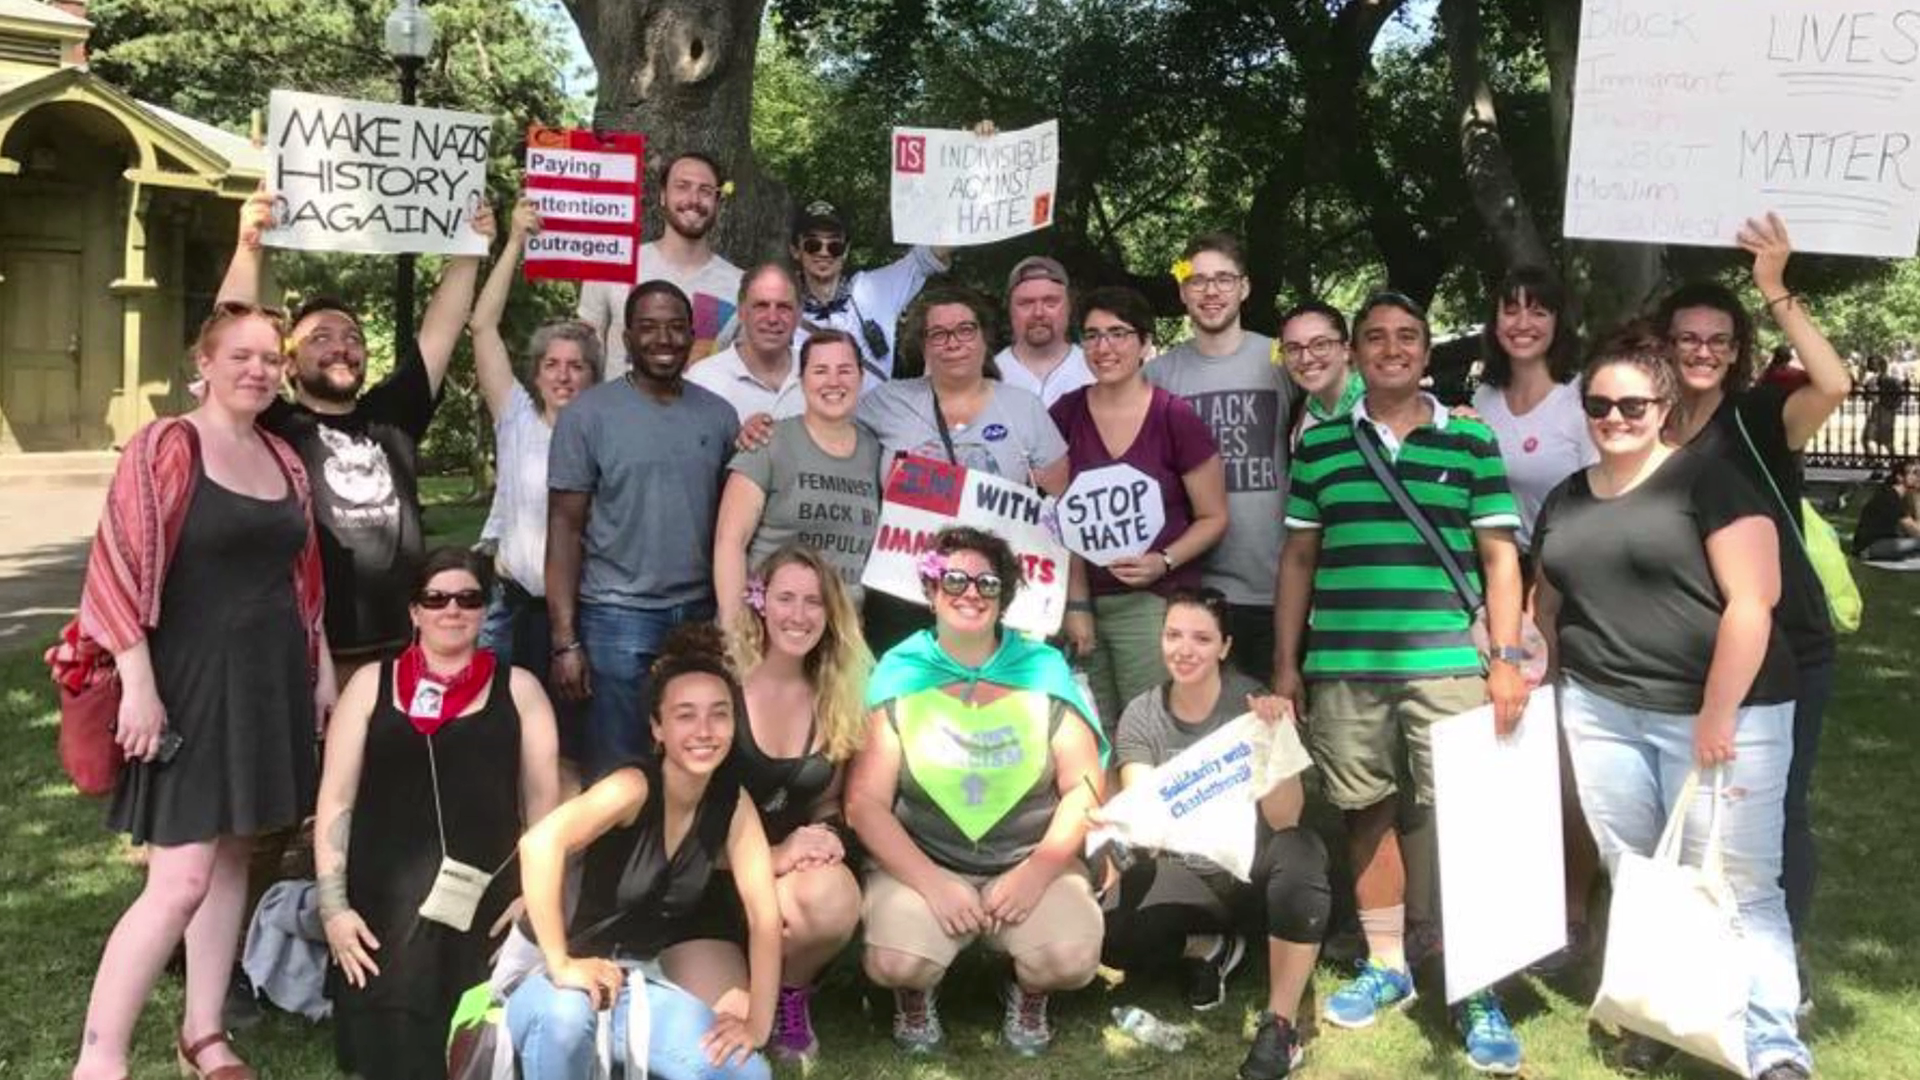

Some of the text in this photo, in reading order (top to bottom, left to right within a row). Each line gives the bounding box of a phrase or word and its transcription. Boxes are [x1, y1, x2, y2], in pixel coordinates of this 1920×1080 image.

[1767, 10, 1920, 65] LIVES
[279, 108, 401, 157] MAKE
[939, 131, 1056, 171] INDIVISIBLE
[531, 153, 602, 178] Paying
[900, 140, 921, 169] IS
[1739, 130, 1917, 191] MATTER
[277, 153, 469, 201] HISTORY
[948, 167, 1033, 201] AGAINST
[289, 200, 464, 239] AGAIN!
[957, 196, 1027, 235] HATE
[528, 236, 626, 257] outraged.
[798, 502, 853, 522] BACK
[976, 481, 1041, 525] WITH
[1066, 480, 1148, 524] STOP
[1080, 515, 1150, 551] HATE
[1159, 760, 1221, 802] Solidarity
